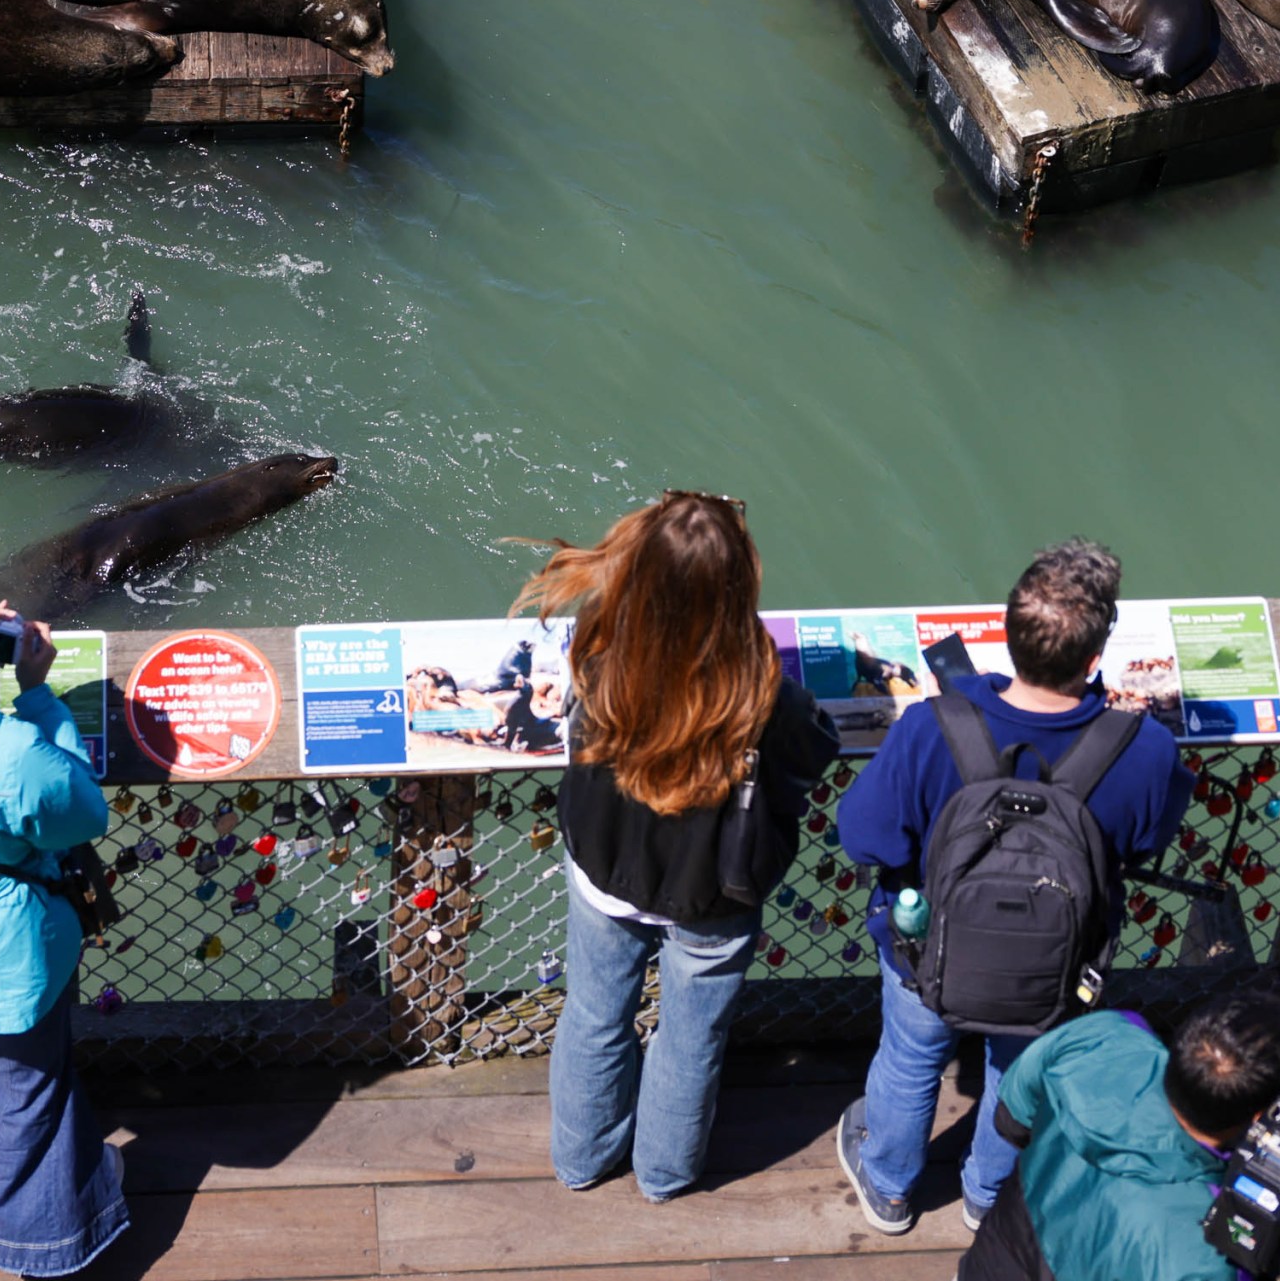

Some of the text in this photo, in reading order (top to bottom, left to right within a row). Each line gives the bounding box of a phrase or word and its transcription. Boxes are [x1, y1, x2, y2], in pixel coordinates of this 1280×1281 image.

[1191, 615, 1211, 624] you
[1210, 612, 1245, 623] know?
[919, 622, 949, 631] When
[305, 639, 389, 651] Why are the
[173, 652, 231, 664] Want to be
[339, 650, 386, 662] LIONS
[161, 664, 243, 677] an ocean hero?
[137, 685, 166, 697] Text
[166, 683, 212, 697] TIPS39
[215, 683, 228, 694] to
[146, 698, 260, 711] for advice on viewing
[155, 710, 252, 722] wildlife safely and
[174, 722, 231, 734] other tips.
